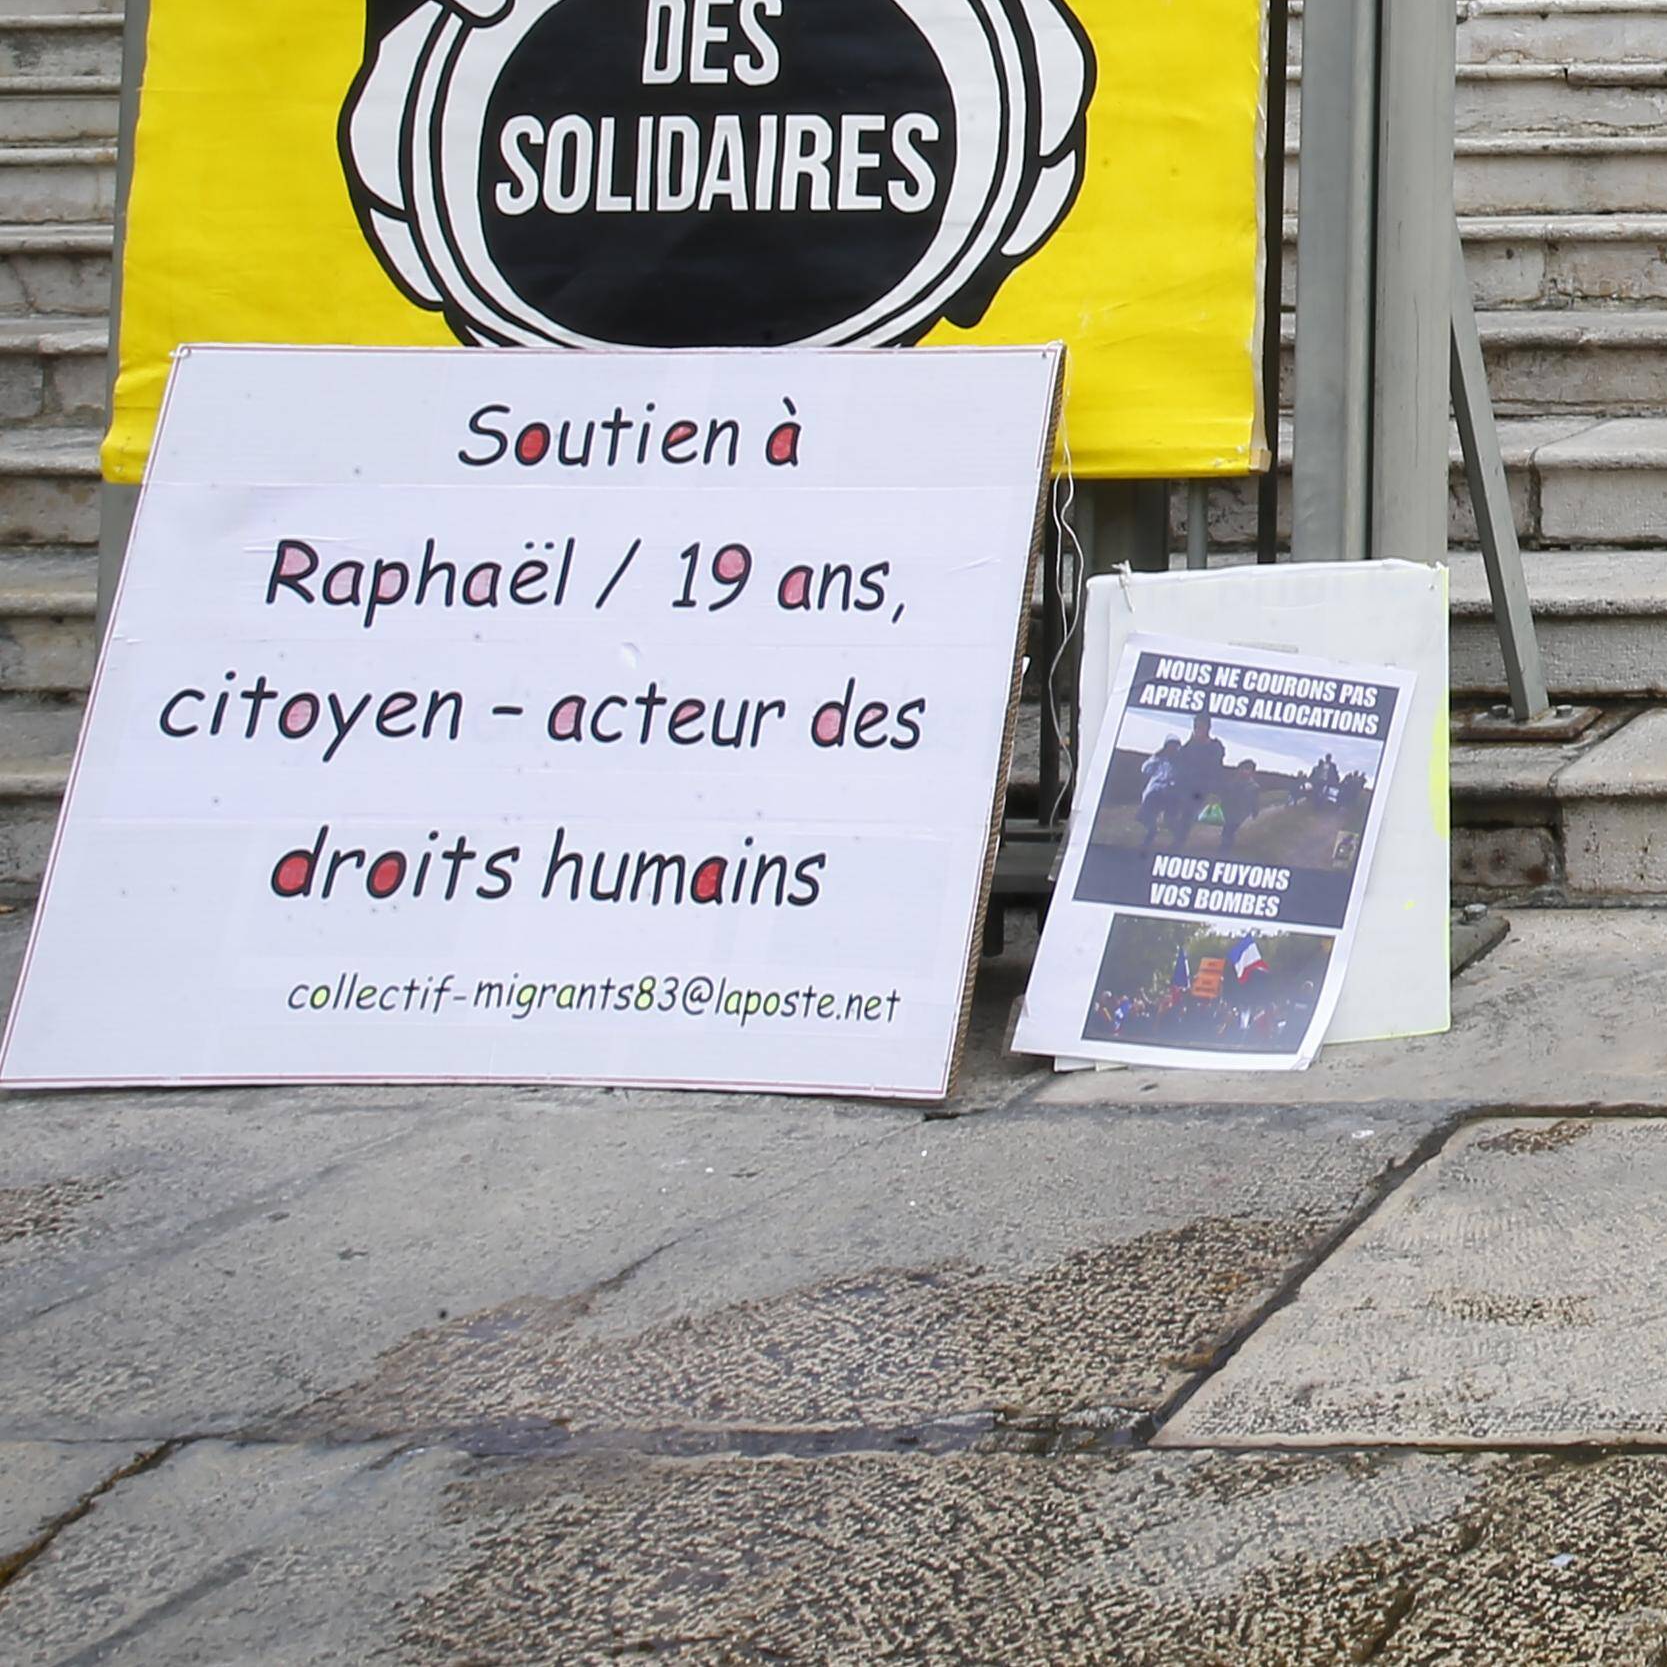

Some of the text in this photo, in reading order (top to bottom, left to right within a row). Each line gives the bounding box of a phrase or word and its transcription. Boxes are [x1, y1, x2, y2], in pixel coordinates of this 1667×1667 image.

[494, 112, 940, 216] SOLIDAIRES
[458, 397, 802, 467] Soutien à
[265, 538, 905, 628] Raphaël / 19 ans,
[1139, 684, 1380, 735] APRÈS VOS ALLOCATIONS
[1156, 658, 1378, 708] NOUS NE COURONS PAS
[158, 671, 464, 763] citoyen
[547, 682, 787, 748] acteur
[811, 678, 925, 750] des
[270, 825, 827, 907] droits humains
[1151, 854, 1291, 891] NOUS FUYONS
[1149, 882, 1281, 918] VOS BOMBES
[287, 971, 902, 1027] collectif-migrants83@laposte.net
